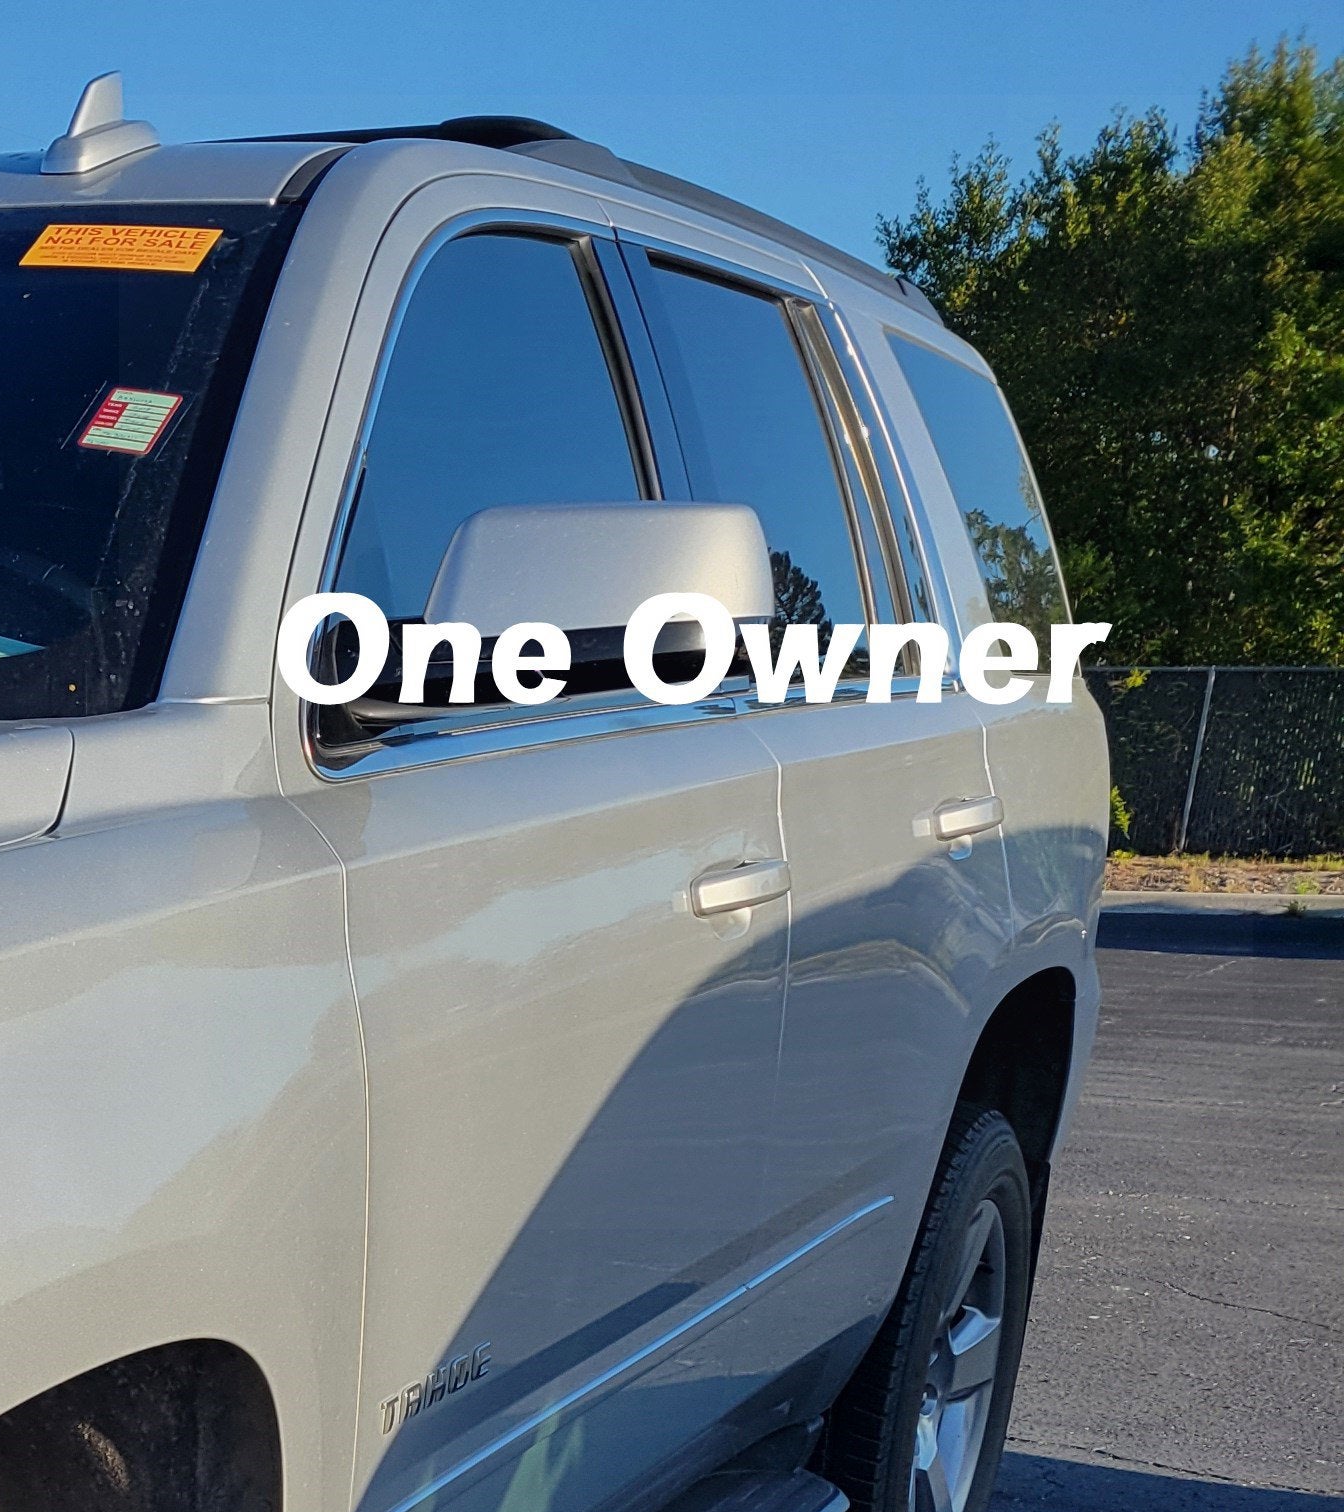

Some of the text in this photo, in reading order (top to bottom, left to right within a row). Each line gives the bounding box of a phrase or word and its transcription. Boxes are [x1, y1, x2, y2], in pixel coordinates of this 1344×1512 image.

[53, 226, 210, 240] THIS VEHICLE
[44, 235, 208, 250] Not FOR SALE
[379, 1340, 492, 1435] TAHOE
